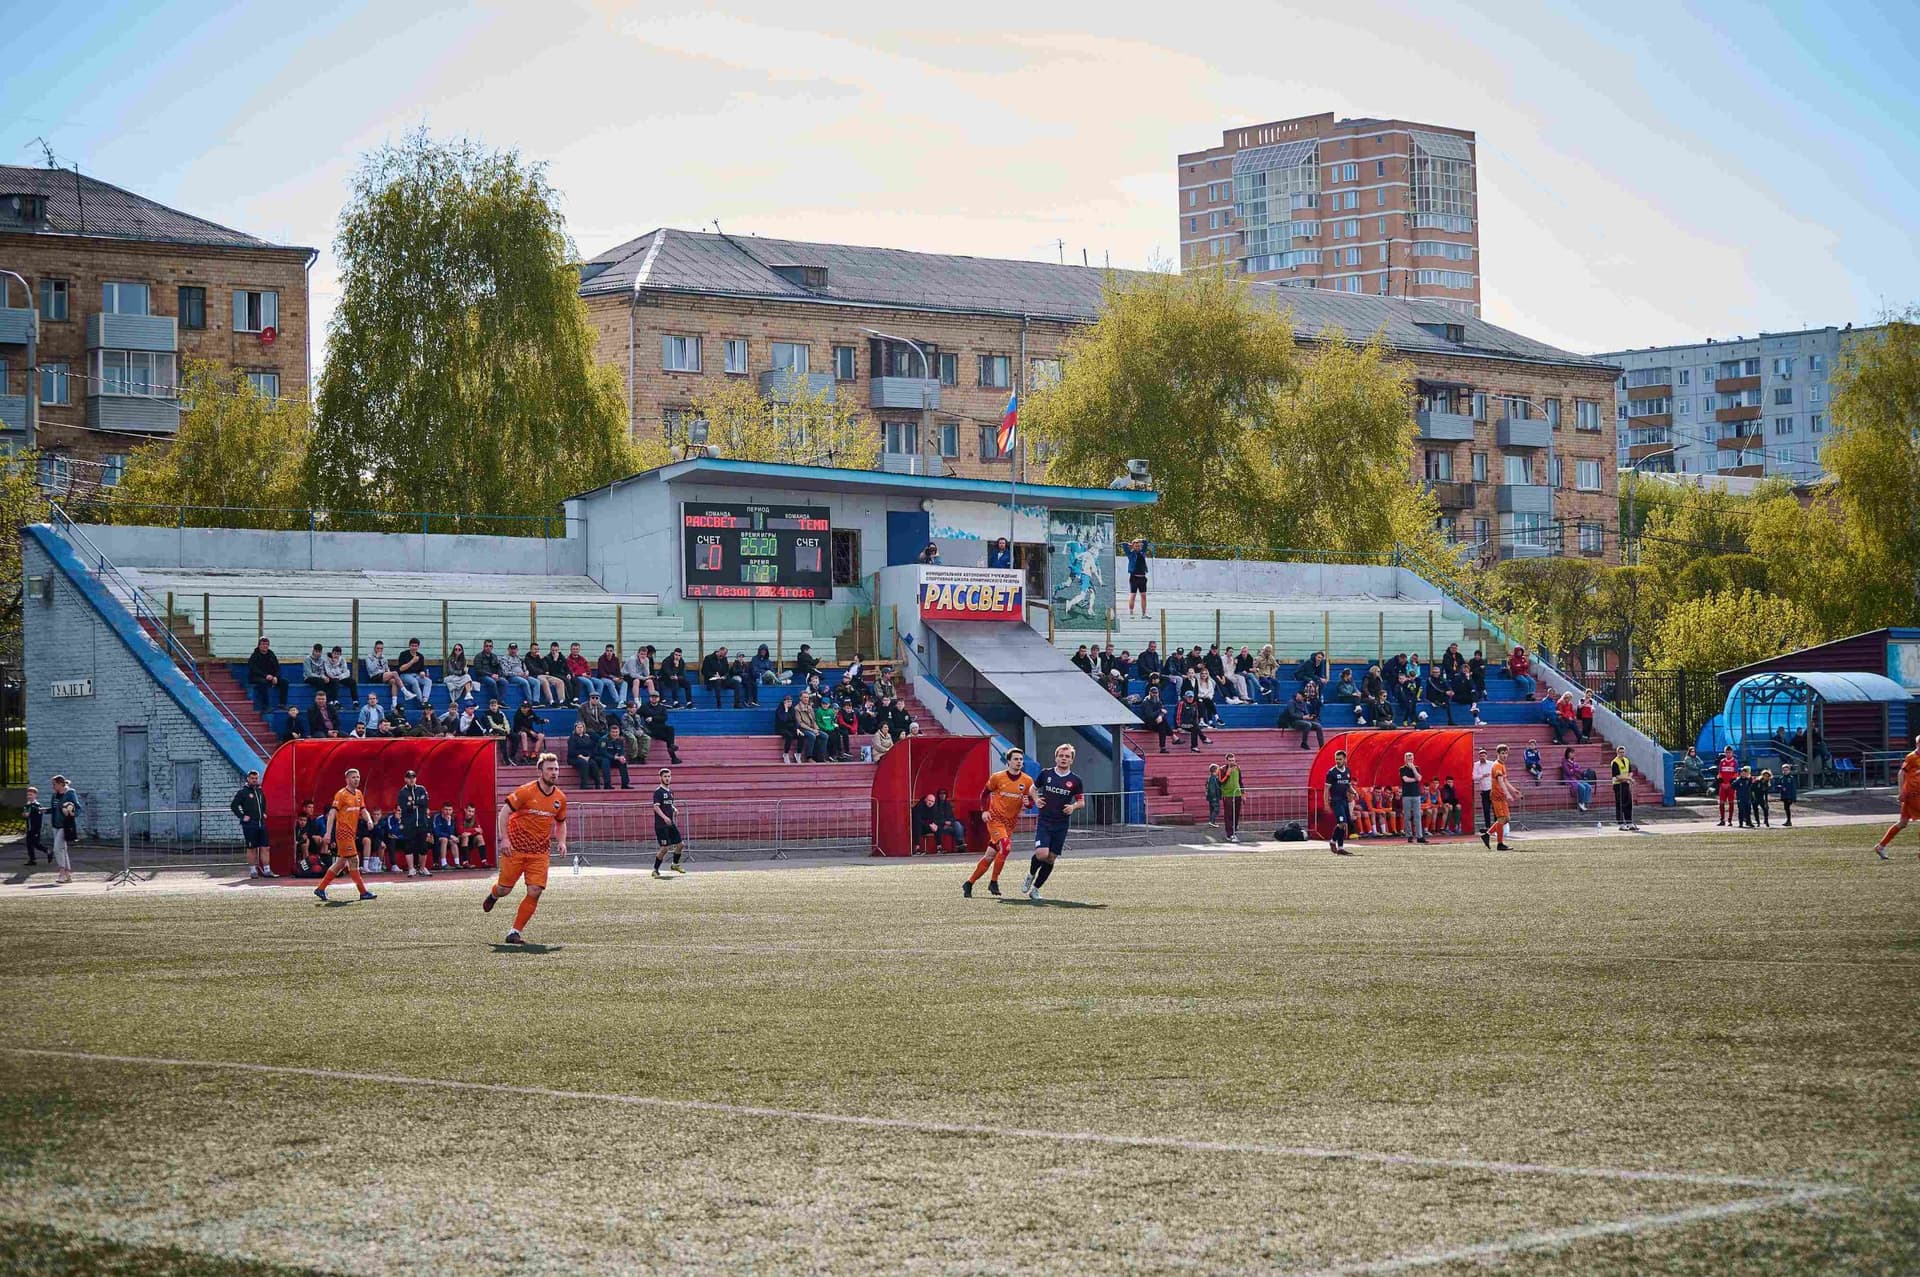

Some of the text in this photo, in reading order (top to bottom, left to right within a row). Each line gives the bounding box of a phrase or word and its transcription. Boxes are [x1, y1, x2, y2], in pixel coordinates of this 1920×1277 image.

[686, 515, 736, 528] РАССВЕТ
[799, 519, 828, 531] ТЕМП
[697, 535, 721, 545] СЧЕТ
[796, 538, 820, 547] СЧЕТ
[709, 544, 722, 571] 0
[716, 585, 751, 597] Сезон
[924, 584, 1018, 612] РАССВЕТ
[51, 683, 85, 697] ТУАЛЕТ
[1045, 785, 1071, 796] РАССВЕТ
